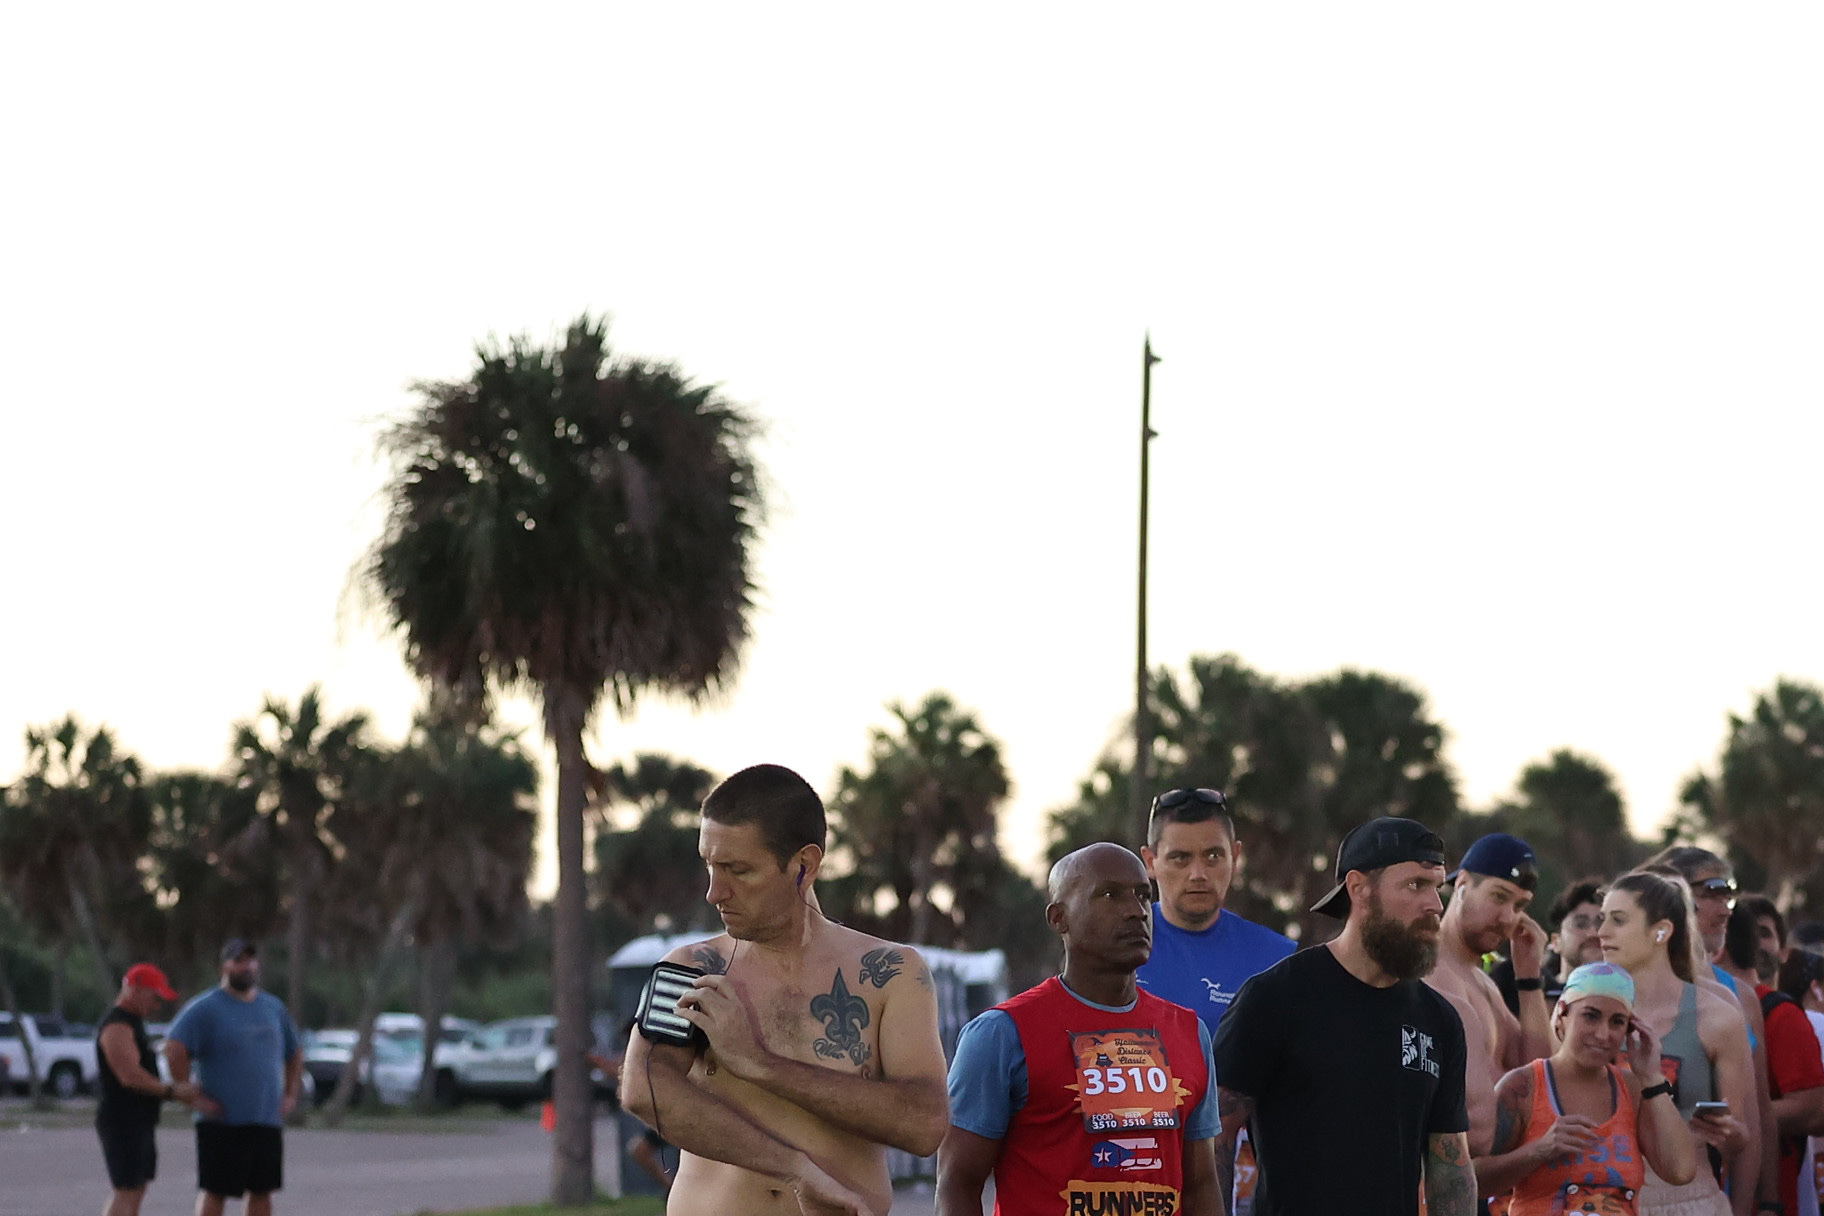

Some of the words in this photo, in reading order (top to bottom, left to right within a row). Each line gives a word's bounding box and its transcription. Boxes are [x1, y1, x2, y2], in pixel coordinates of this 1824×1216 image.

[1083, 1067, 1167, 1095] 3510
[1092, 1120, 1117, 1129] 3510
[1122, 1118, 1146, 1127] 3510
[1152, 1118, 1175, 1126] 3510
